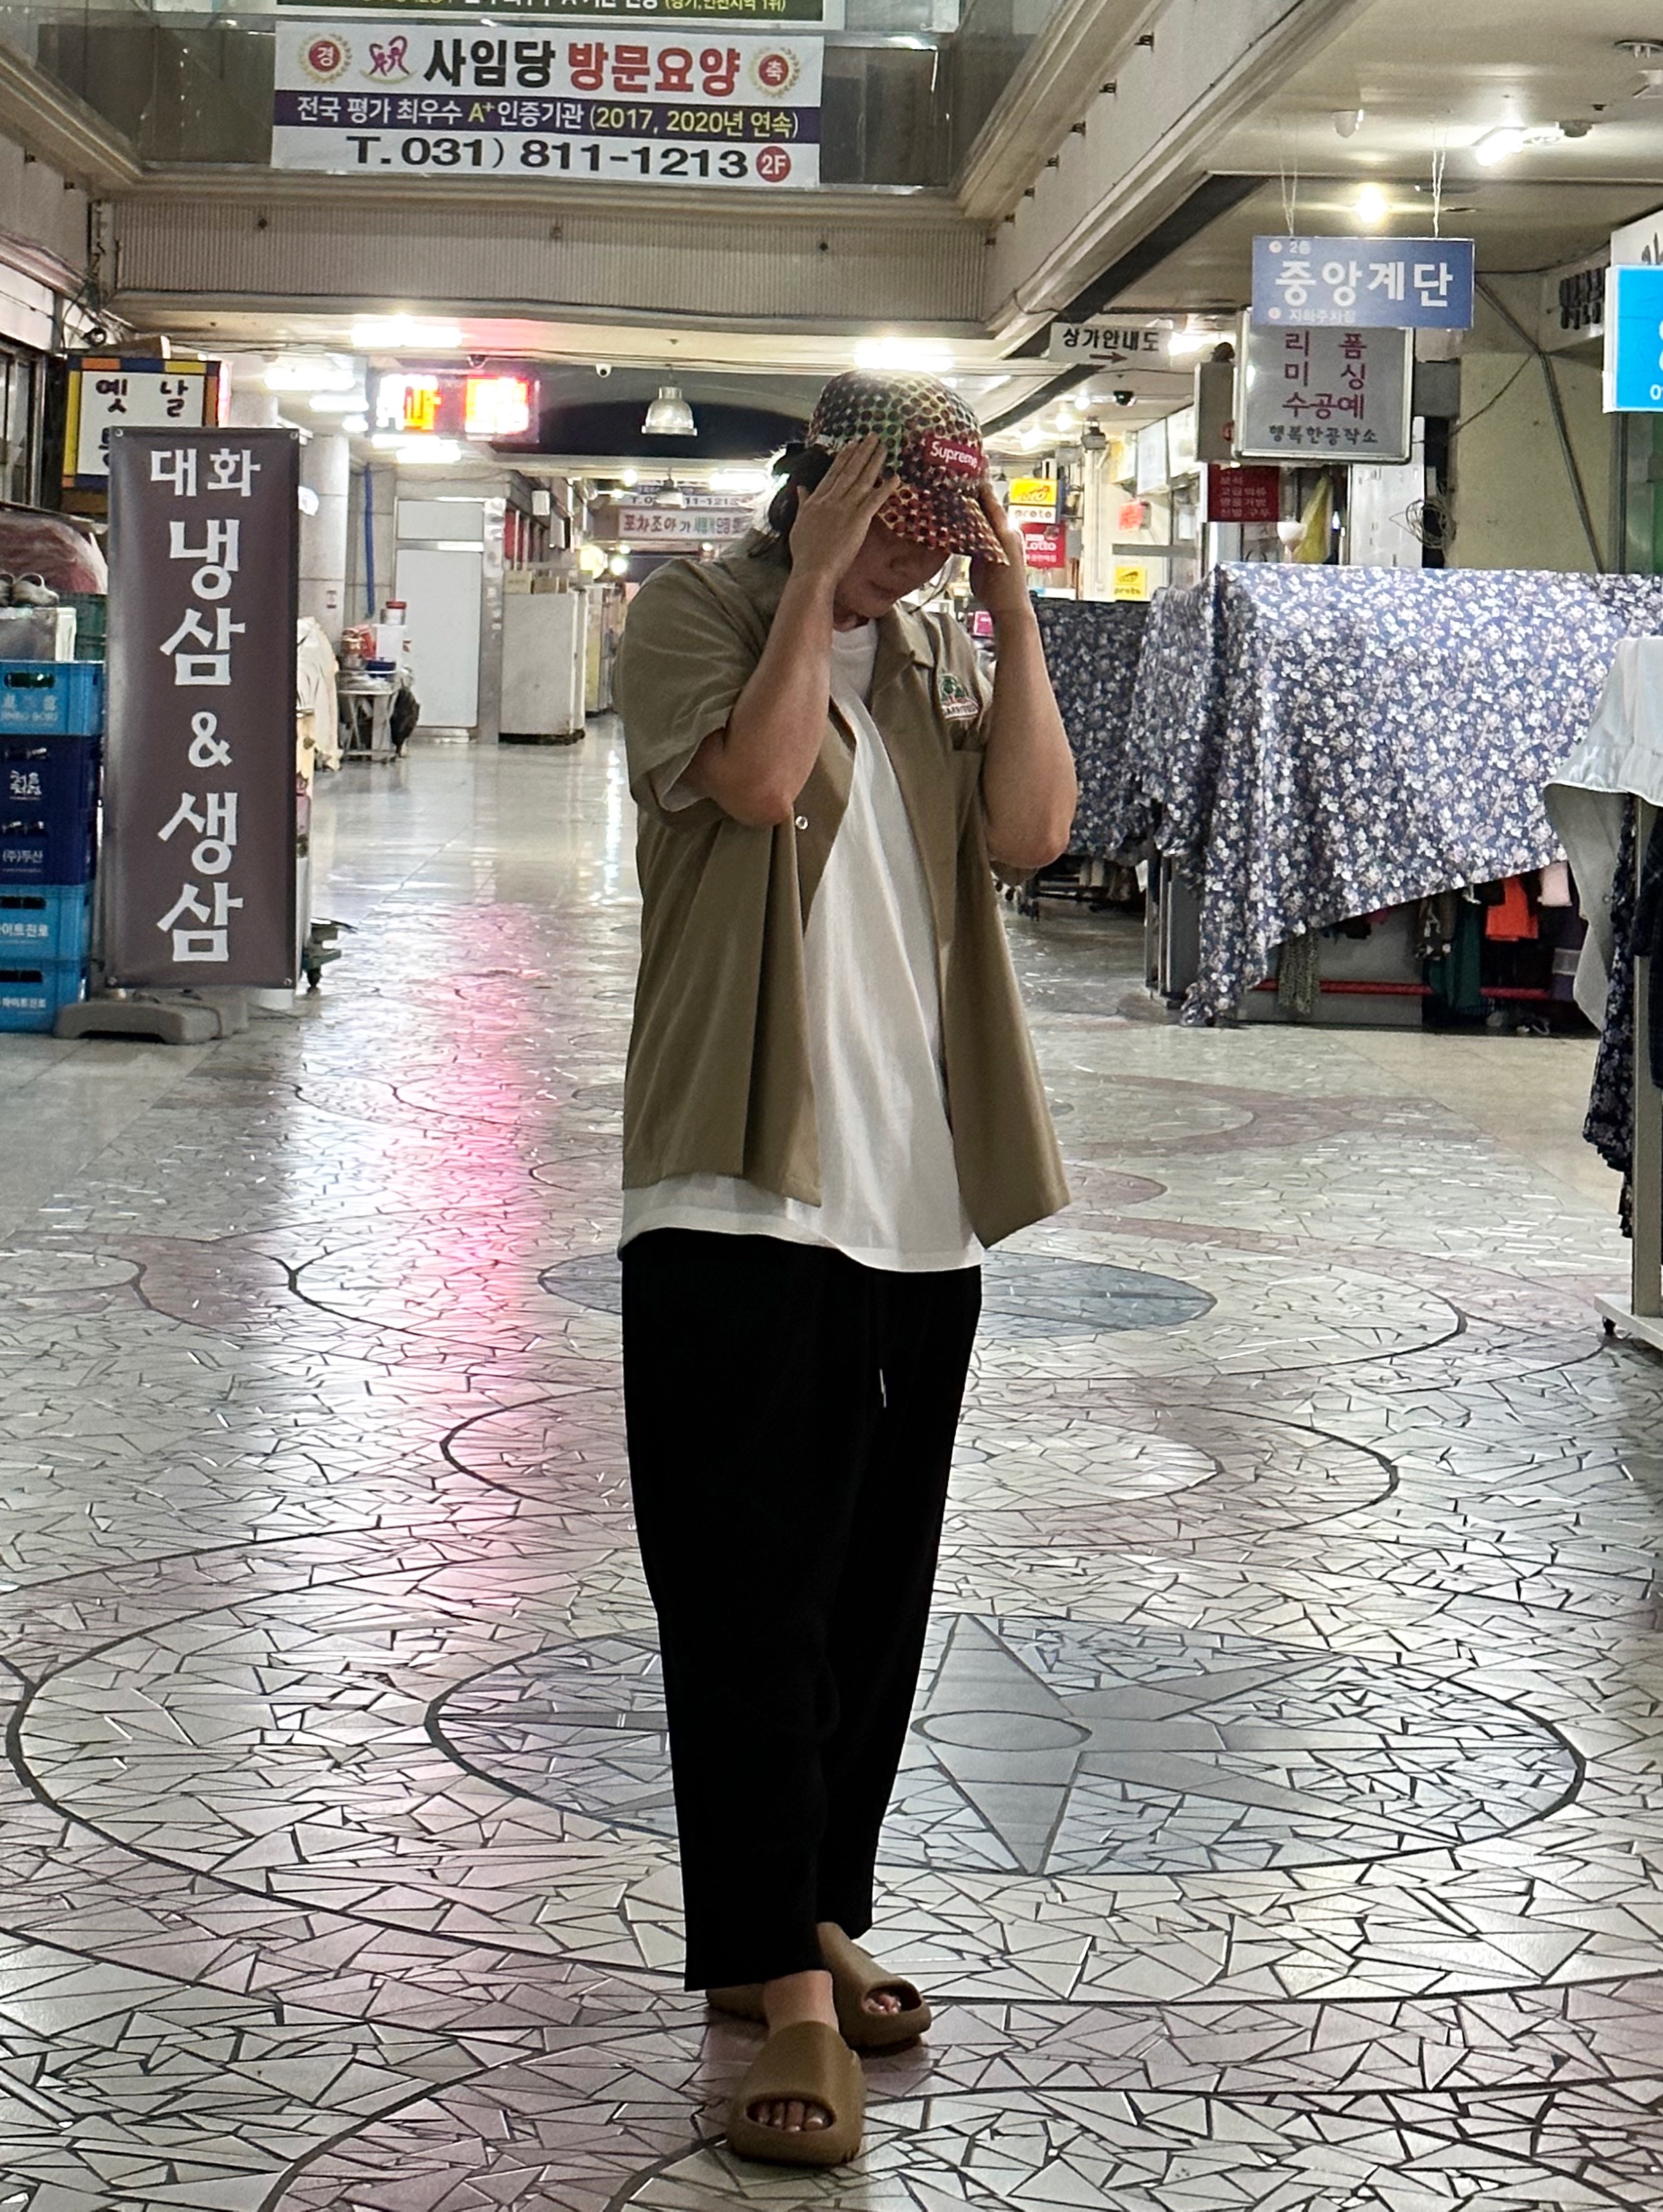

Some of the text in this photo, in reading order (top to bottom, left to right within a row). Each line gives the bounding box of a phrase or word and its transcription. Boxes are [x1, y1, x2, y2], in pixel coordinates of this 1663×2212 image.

[424, 38, 741, 97] 사임당 방문요양
[765, 58, 784, 81] 축
[298, 96, 342, 122] 전국
[347, 97, 392, 124] 평가
[396, 98, 463, 124] 최우수
[590, 105, 659, 134] (2017,
[666, 110, 743, 137] 2020년
[750, 112, 799, 139] 연속)
[520, 139, 749, 178] 811-1213
[760, 154, 787, 174] 2F
[1275, 260, 1454, 307] 중앙계단
[1063, 328, 1159, 352] 상가안내도
[1282, 392, 1365, 420] 수공예
[150, 447, 261, 497] 대화
